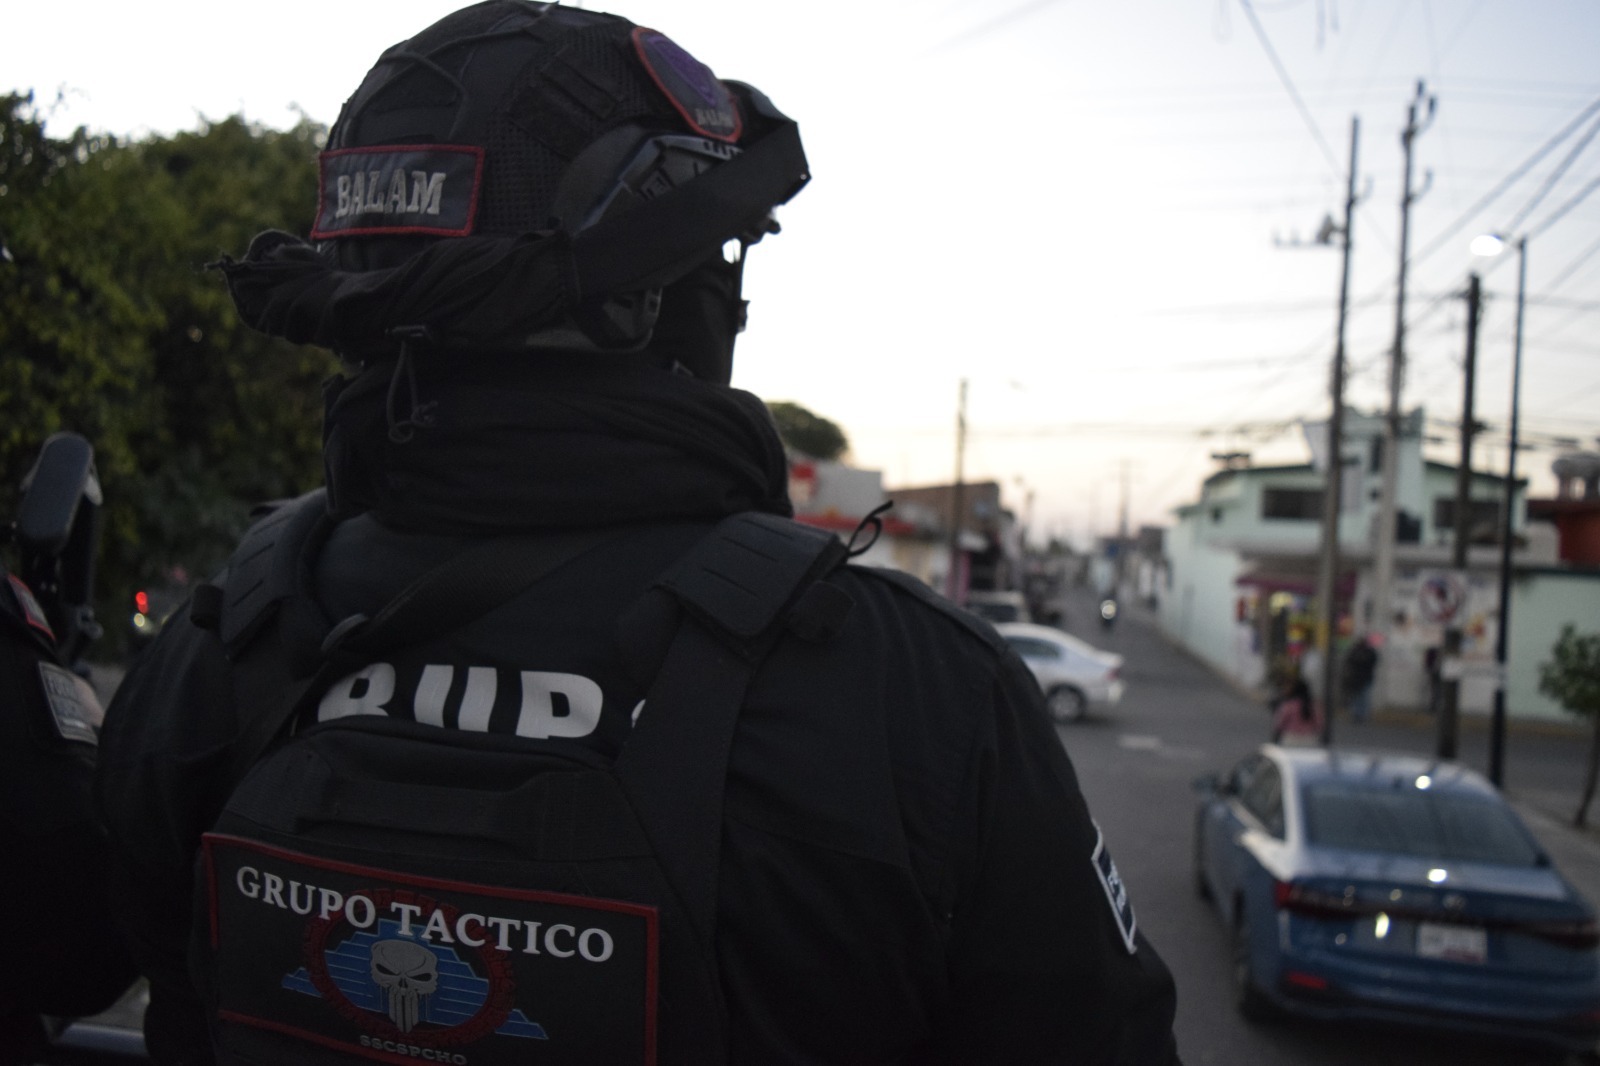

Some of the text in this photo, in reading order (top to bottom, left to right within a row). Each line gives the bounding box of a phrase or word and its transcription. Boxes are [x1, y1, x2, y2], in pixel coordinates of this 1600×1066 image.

[335, 171, 446, 217] BALAM
[236, 866, 614, 962] GRUPO TACTICO
[360, 1035, 468, 1065] SSCSPCHO
